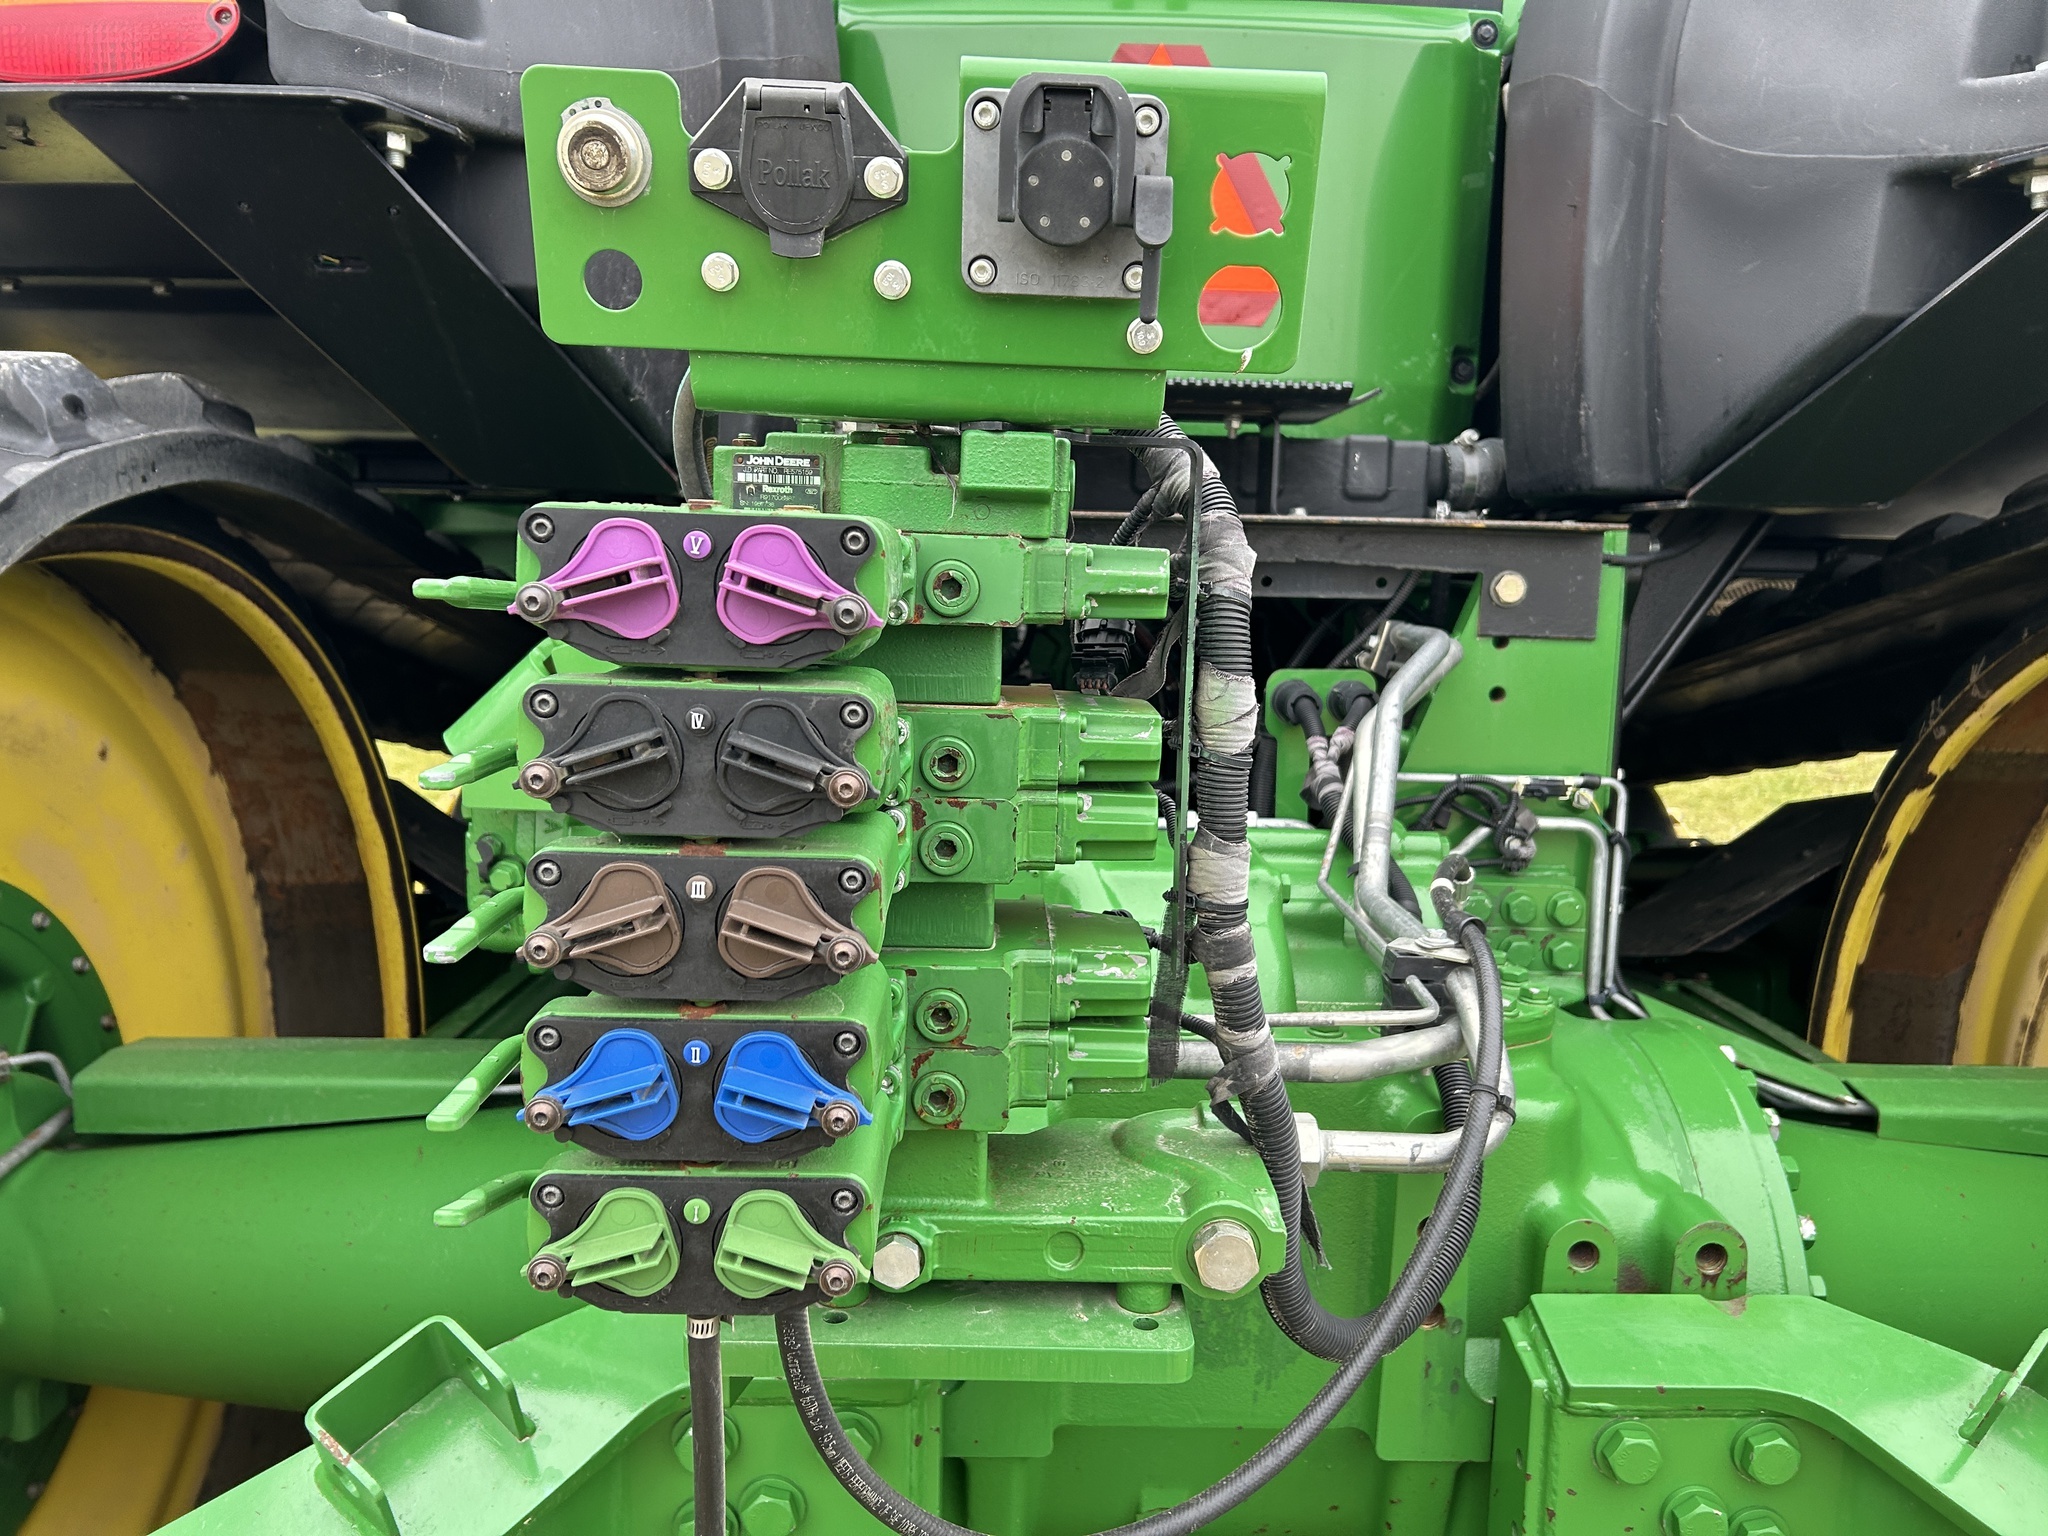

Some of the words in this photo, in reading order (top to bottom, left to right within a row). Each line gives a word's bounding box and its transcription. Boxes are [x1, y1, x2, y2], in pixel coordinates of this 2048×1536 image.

[758, 158, 831, 189] Pollak
[1015, 272, 1040, 286] ISO
[1052, 274, 1105, 289] 11783-2
[746, 455, 775, 466] JOHN
[775, 455, 811, 467] DEERE
[762, 484, 793, 494] Rexroth
[689, 535, 704, 555] V
[690, 711, 705, 730] IV
[691, 882, 707, 899] III
[691, 1046, 701, 1064] II
[693, 1205, 700, 1222] I
